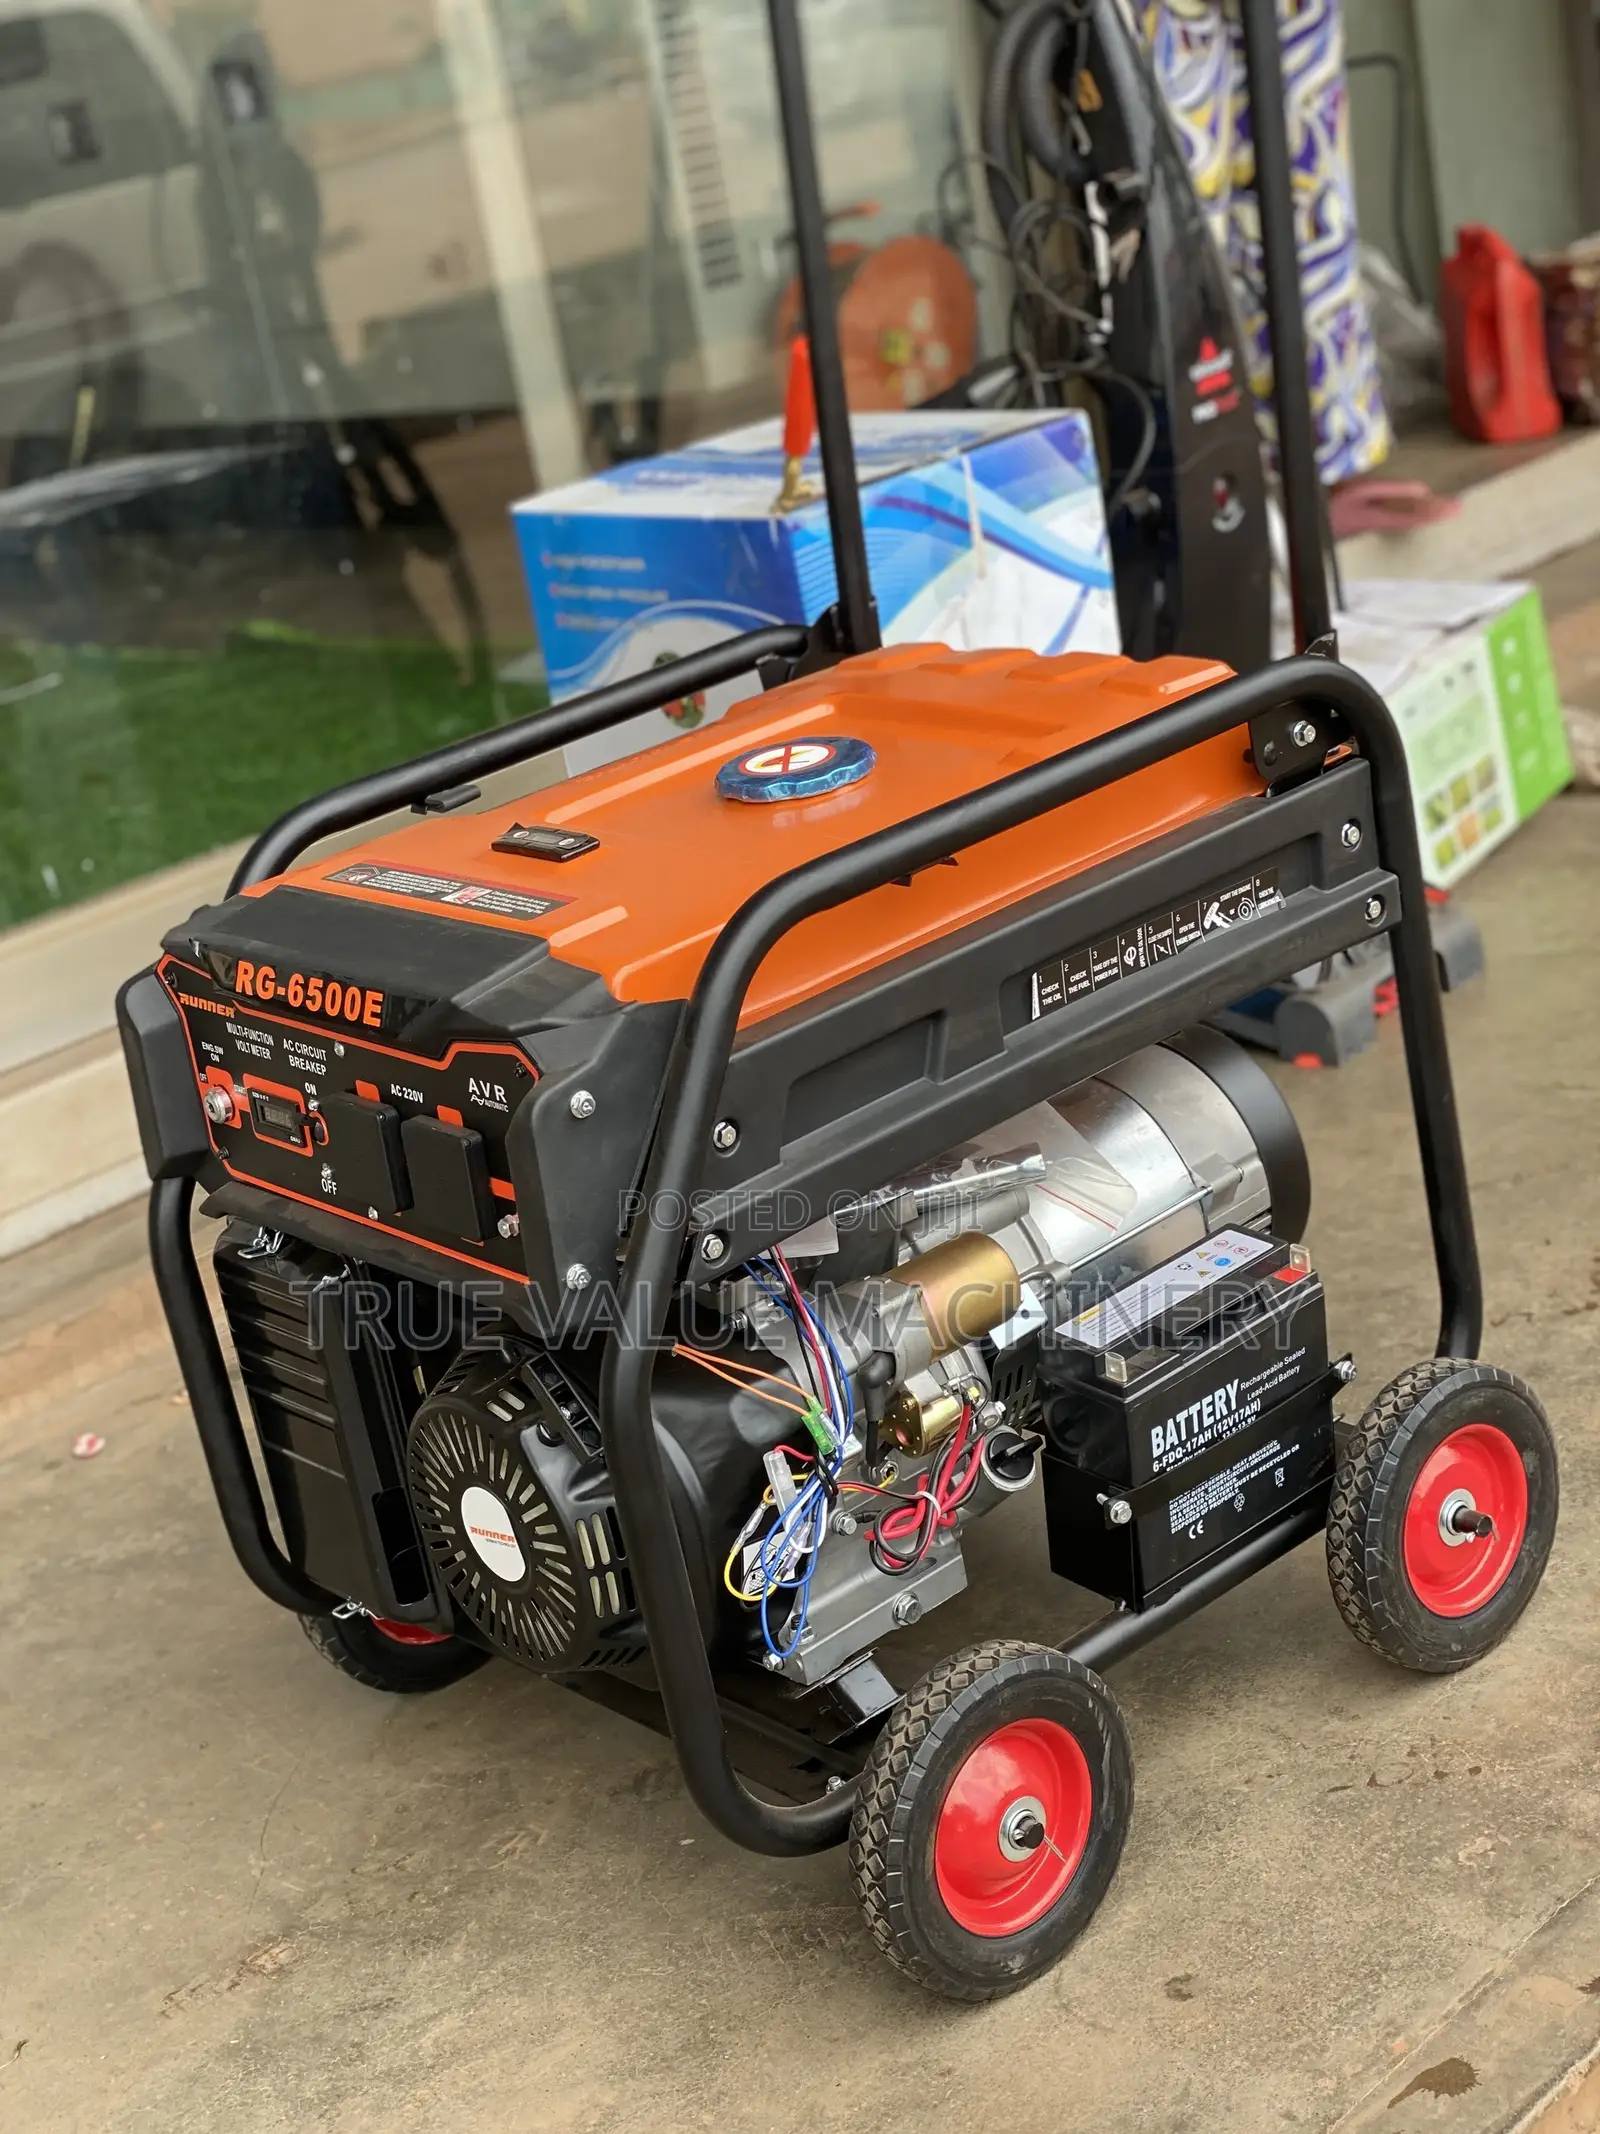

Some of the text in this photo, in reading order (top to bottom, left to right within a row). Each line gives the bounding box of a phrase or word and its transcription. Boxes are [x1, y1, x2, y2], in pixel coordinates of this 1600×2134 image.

[1203, 902, 1208, 910] 7
[1175, 914, 1181, 922] 6
[1148, 925, 1154, 934] 5
[1121, 938, 1126, 946] 4
[1092, 951, 1098, 959] 3
[1064, 963, 1069, 972] 2
[1070, 970, 1087, 982] CHECK
[235, 960, 383, 1028] RG-6500E
[1041, 982, 1060, 995] CHECK
[1068, 979, 1091, 994] THE FUEL
[178, 991, 236, 1018] RUNNER
[1042, 993, 1063, 1006] THE OIL
[226, 1021, 275, 1046] MULTI-FUNCTION
[210, 1053, 220, 1062] ON
[235, 1039, 272, 1061] VOLT METER
[283, 1038, 327, 1062] AC CIRCUIT
[304, 1081, 317, 1096] ON
[390, 1083, 424, 1104] AC 220V
[321, 1178, 337, 1195] OFF
[1240, 1346, 1306, 1391] Rechargeable Sealed
[1247, 1364, 1301, 1401] Lead-Acid Battery
[1150, 1378, 1239, 1459] BATTERY
[1152, 1398, 1261, 1473] 6-FDQ-17AH (12V17AH)
[1208, 1485, 1234, 1505] BATTERY
[1234, 1475, 1250, 1488] MUST
[1250, 1469, 1259, 1479] BE
[1291, 1444, 1300, 1453] OR
[1169, 1501, 1178, 1511] DO
[1179, 1493, 1190, 1504] NOT
[1170, 1514, 1177, 1522] IN
[1182, 1497, 1204, 1514] SEALED
[1171, 1512, 1200, 1535] DISPOSED
[1200, 1506, 1208, 1516] OF
[1188, 1519, 1204, 1539] CE
[469, 1526, 515, 1544] RUNNER
